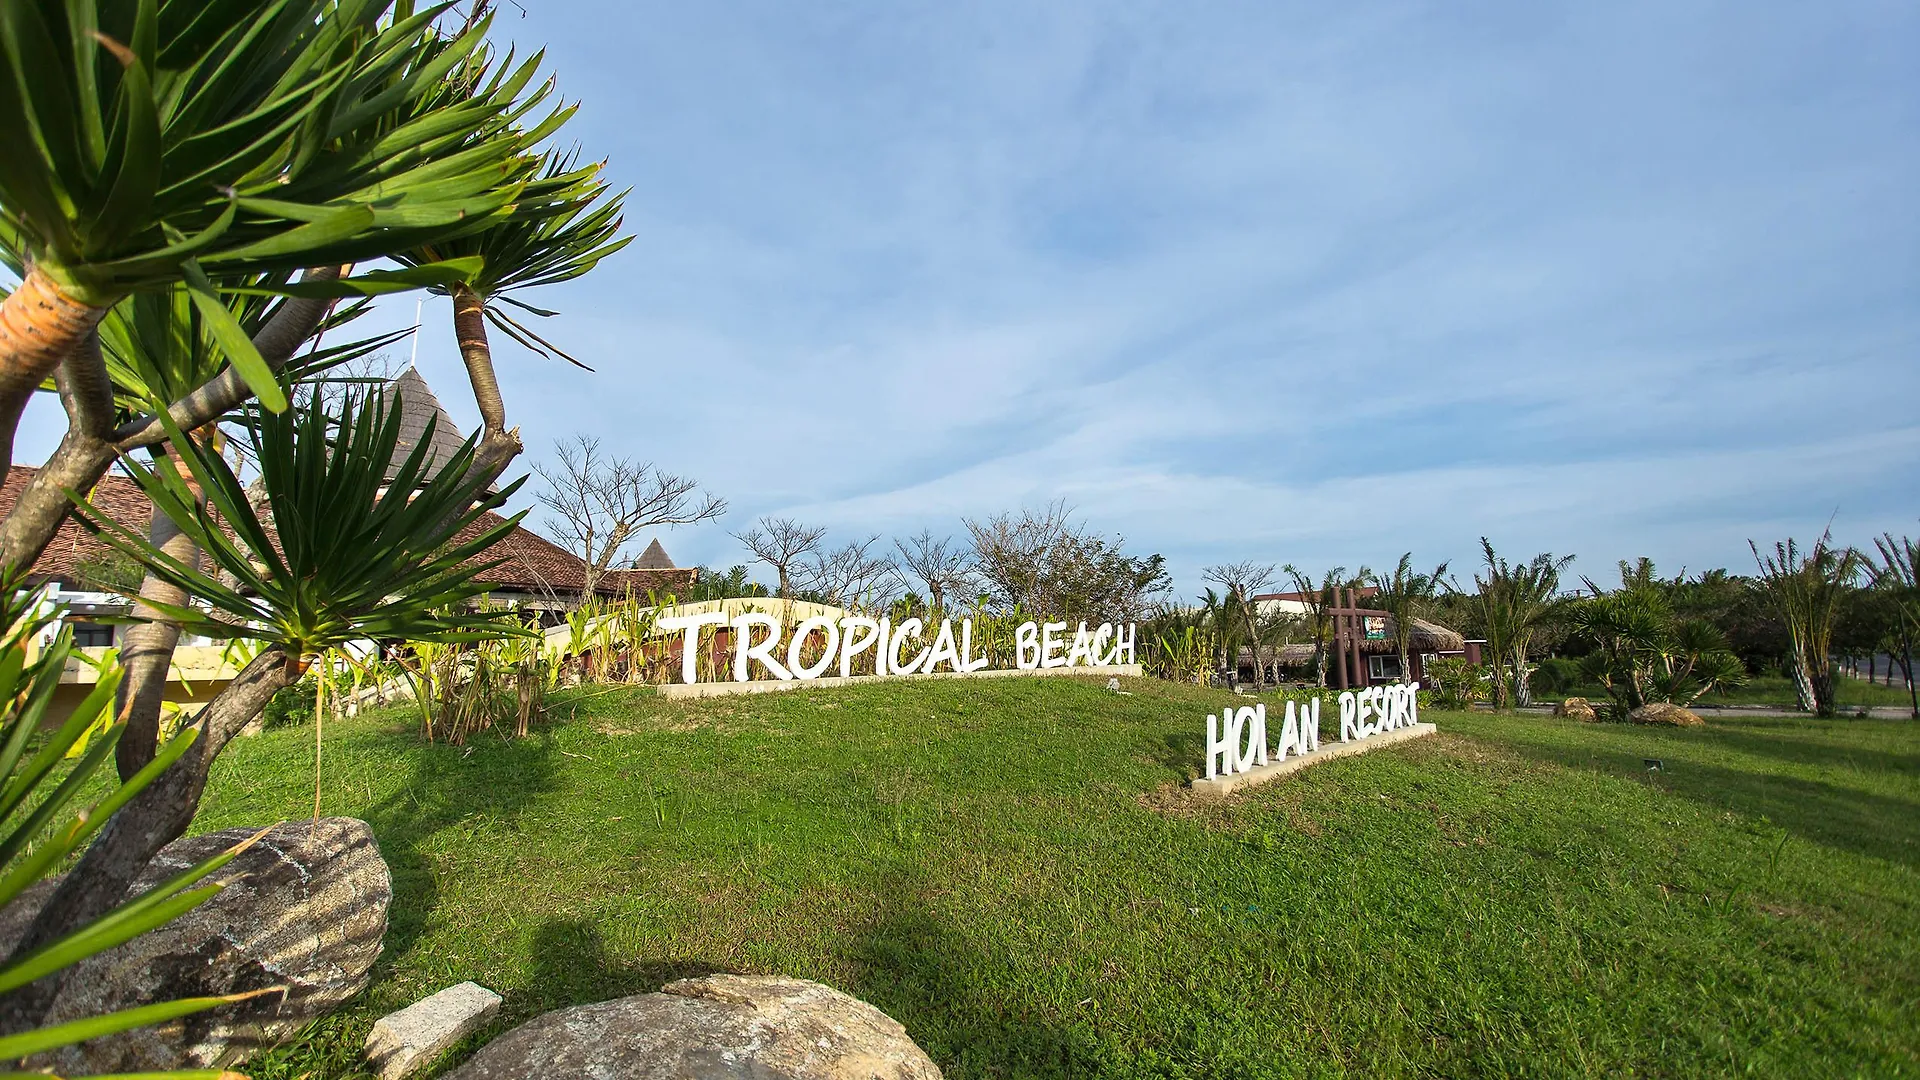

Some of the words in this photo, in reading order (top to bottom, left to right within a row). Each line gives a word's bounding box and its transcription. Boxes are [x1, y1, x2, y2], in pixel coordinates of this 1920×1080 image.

[659, 613, 988, 684] TROPICAL
[1015, 621, 1136, 669] BEACH
[1206, 703, 1268, 781] HOI
[1276, 697, 1320, 762] AN
[1338, 681, 1420, 743] RESORT
